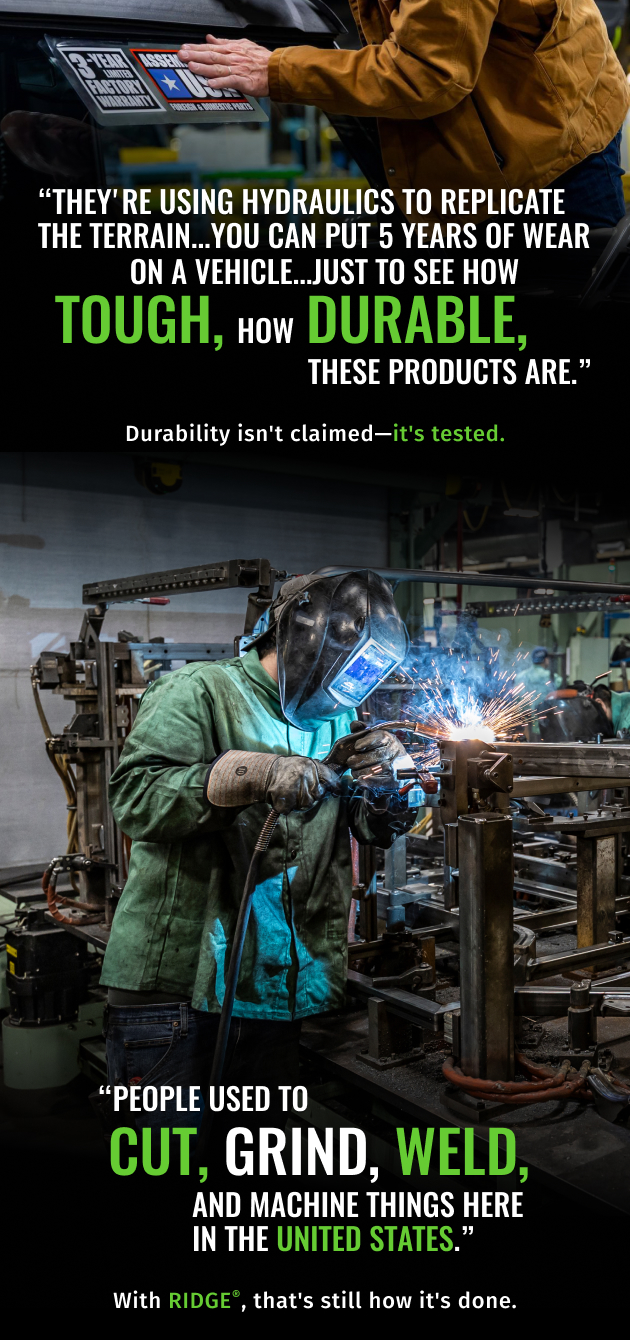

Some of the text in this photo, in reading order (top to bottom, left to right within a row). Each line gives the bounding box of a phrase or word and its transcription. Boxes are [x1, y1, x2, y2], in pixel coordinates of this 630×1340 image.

[68, 53, 129, 79] 3-YEAR
[138, 54, 189, 68] ASSEM
[103, 69, 134, 78] LIMITED
[84, 80, 145, 95] FACTORY
[95, 95, 154, 107] WARRANTY
[230, 102, 253, 111] PARTS
